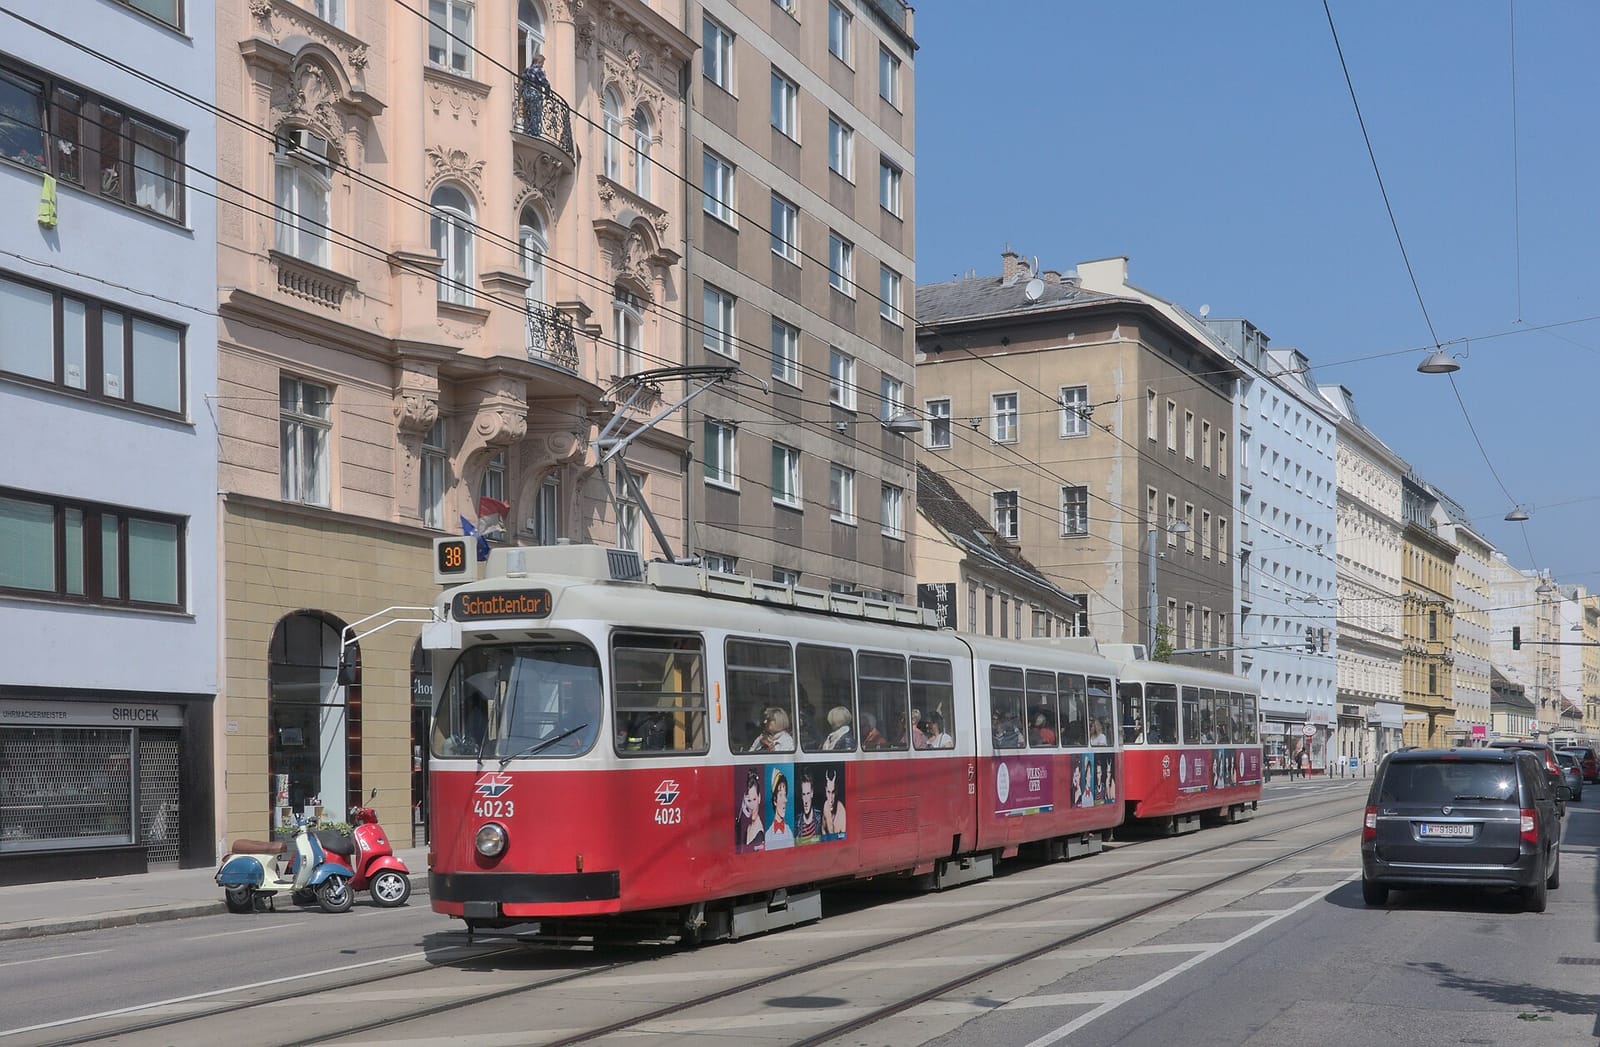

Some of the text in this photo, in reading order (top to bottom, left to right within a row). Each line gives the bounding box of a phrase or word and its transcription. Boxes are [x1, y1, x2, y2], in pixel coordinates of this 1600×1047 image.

[445, 546, 461, 566] 38
[462, 594, 541, 615] Schottentor
[3, 710, 67, 719] UHRMACHERMEISTER
[112, 707, 159, 721] SIRUCEK
[474, 800, 515, 818] 4023
[654, 807, 681, 825] 4023
